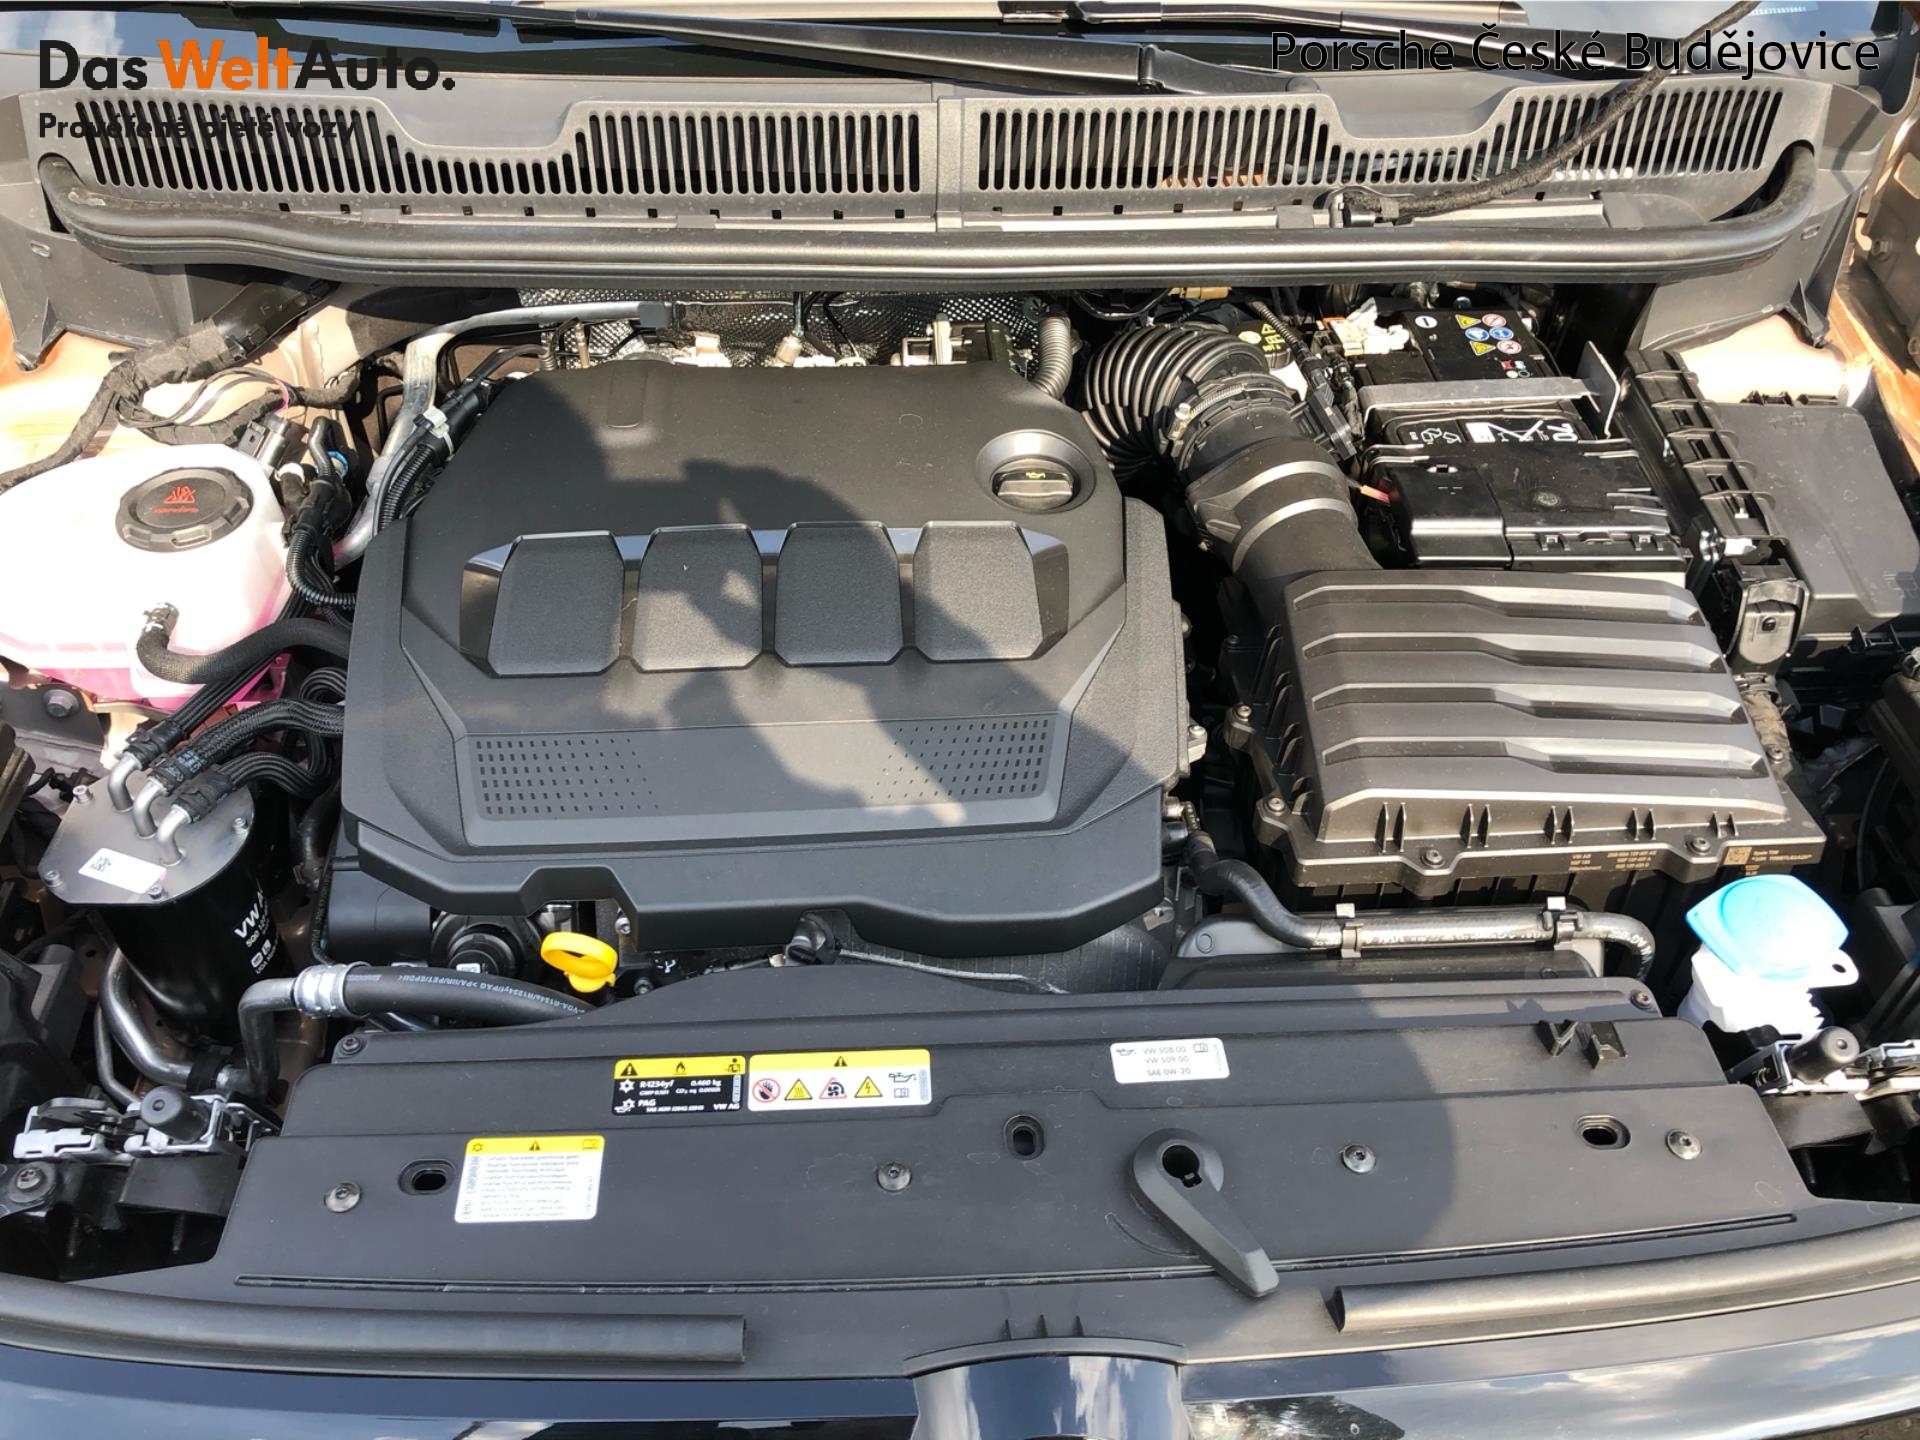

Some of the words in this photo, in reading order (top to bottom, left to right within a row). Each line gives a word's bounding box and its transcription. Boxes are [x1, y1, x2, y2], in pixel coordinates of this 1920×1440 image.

[234, 902, 261, 939] VW
[712, 1079, 722, 1087] kg
[638, 1098, 656, 1107] PAG
[713, 1103, 727, 1111] VW
